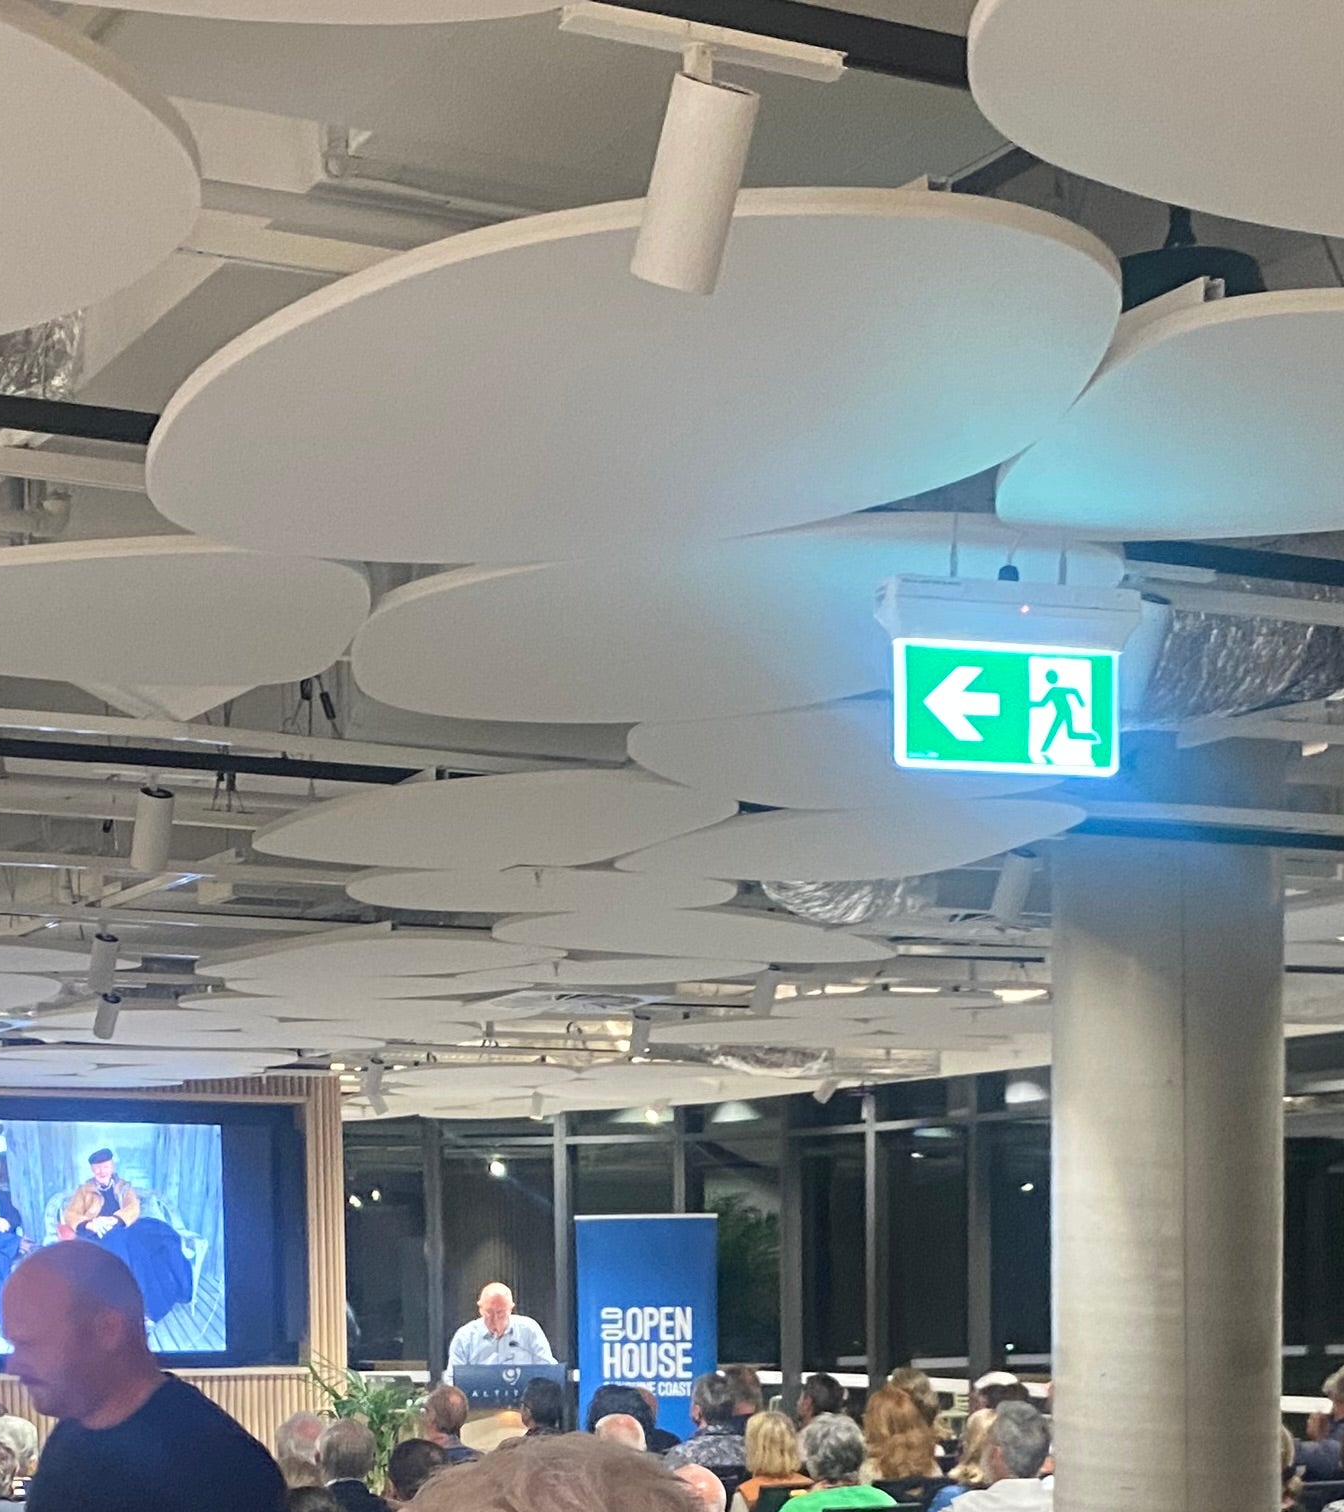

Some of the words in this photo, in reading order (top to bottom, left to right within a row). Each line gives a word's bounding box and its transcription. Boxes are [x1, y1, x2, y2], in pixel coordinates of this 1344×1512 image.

[600, 1306, 624, 1341] QLD
[625, 1306, 693, 1341] OPEN
[602, 1342, 693, 1379] HOUSE
[471, 1389, 520, 1398] ALTIT
[658, 1381, 693, 1397] COAST
